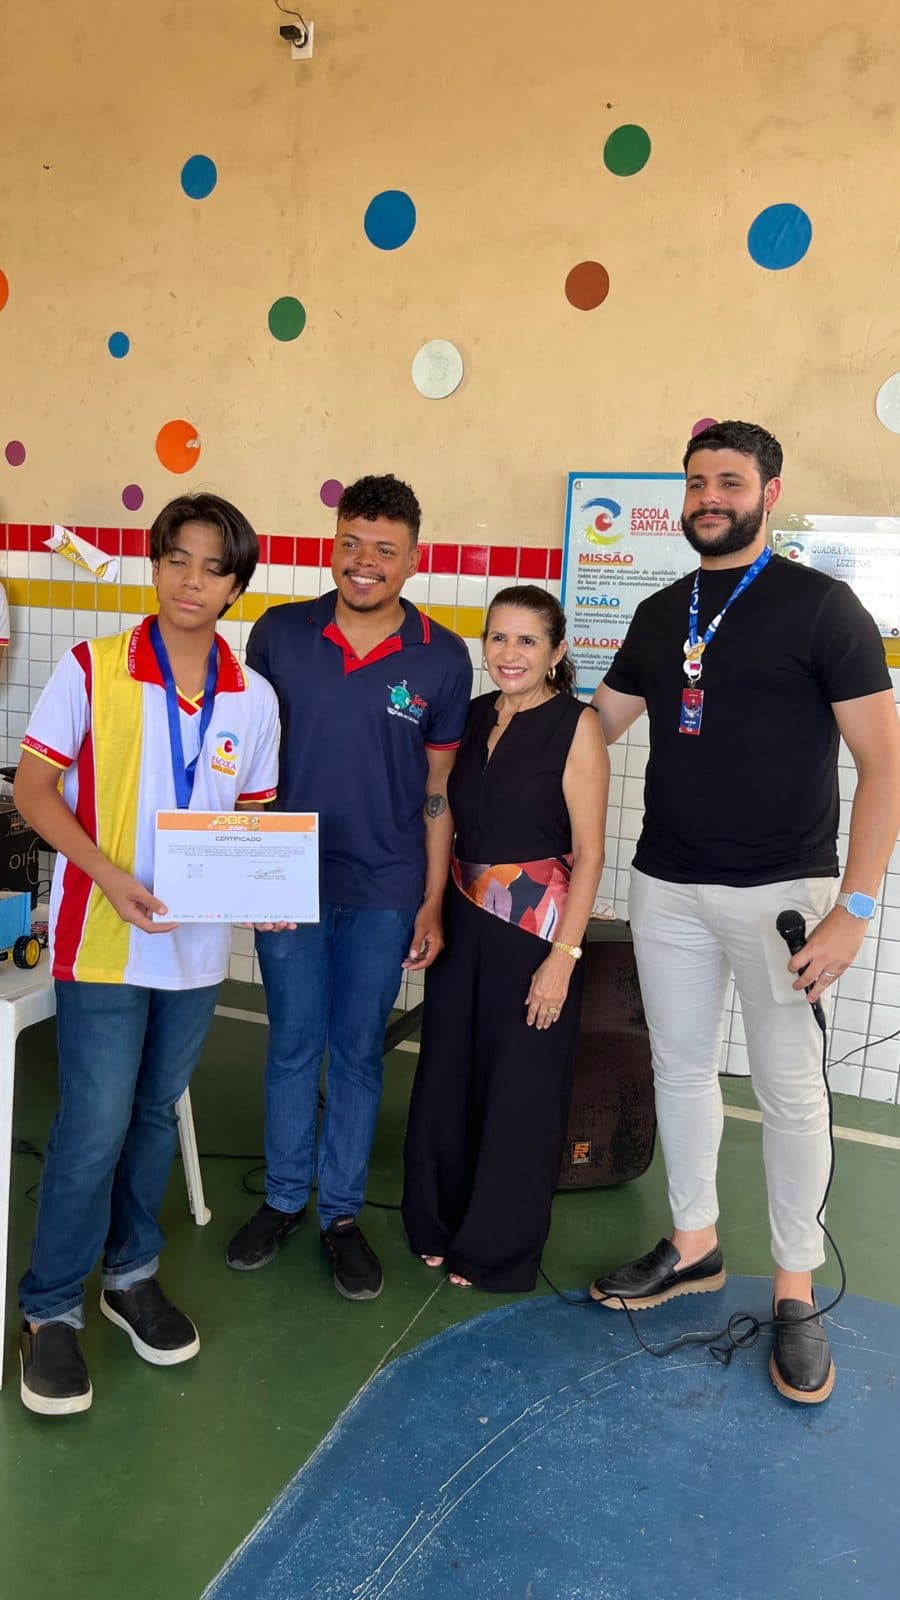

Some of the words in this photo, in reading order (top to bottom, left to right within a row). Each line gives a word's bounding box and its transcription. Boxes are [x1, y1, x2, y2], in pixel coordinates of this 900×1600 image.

[631, 508, 670, 520] ESCOLA
[630, 520, 668, 532] SANTA
[671, 520, 684, 532] LU
[811, 546, 841, 555] QUADRA
[578, 551, 634, 564] MISSÃO
[836, 559, 873, 568] LUZIENSE
[575, 594, 621, 607] VISÃO
[216, 815, 249, 825] OBR
